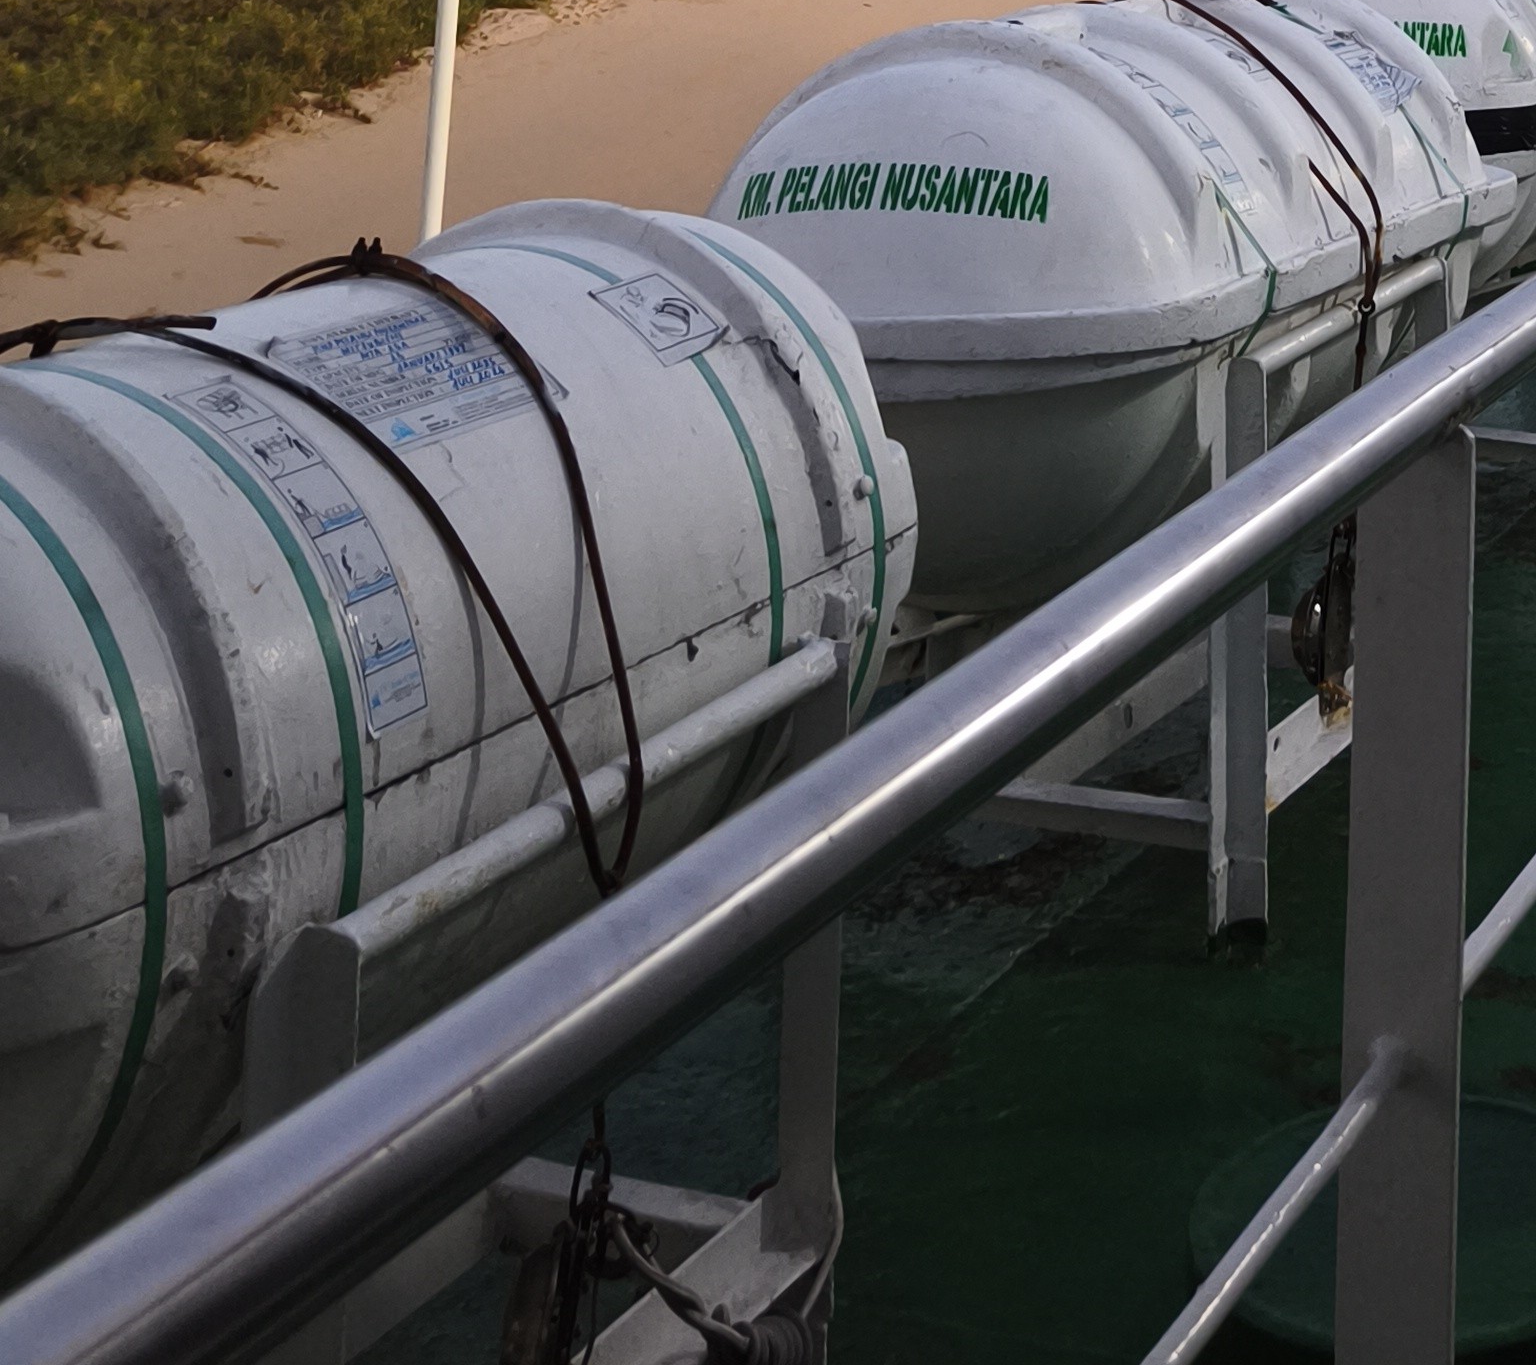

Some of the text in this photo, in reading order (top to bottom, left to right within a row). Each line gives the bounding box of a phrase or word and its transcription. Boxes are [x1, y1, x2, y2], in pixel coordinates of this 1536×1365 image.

[737, 162, 1049, 224] KM. PELANGI NUSANTARA
